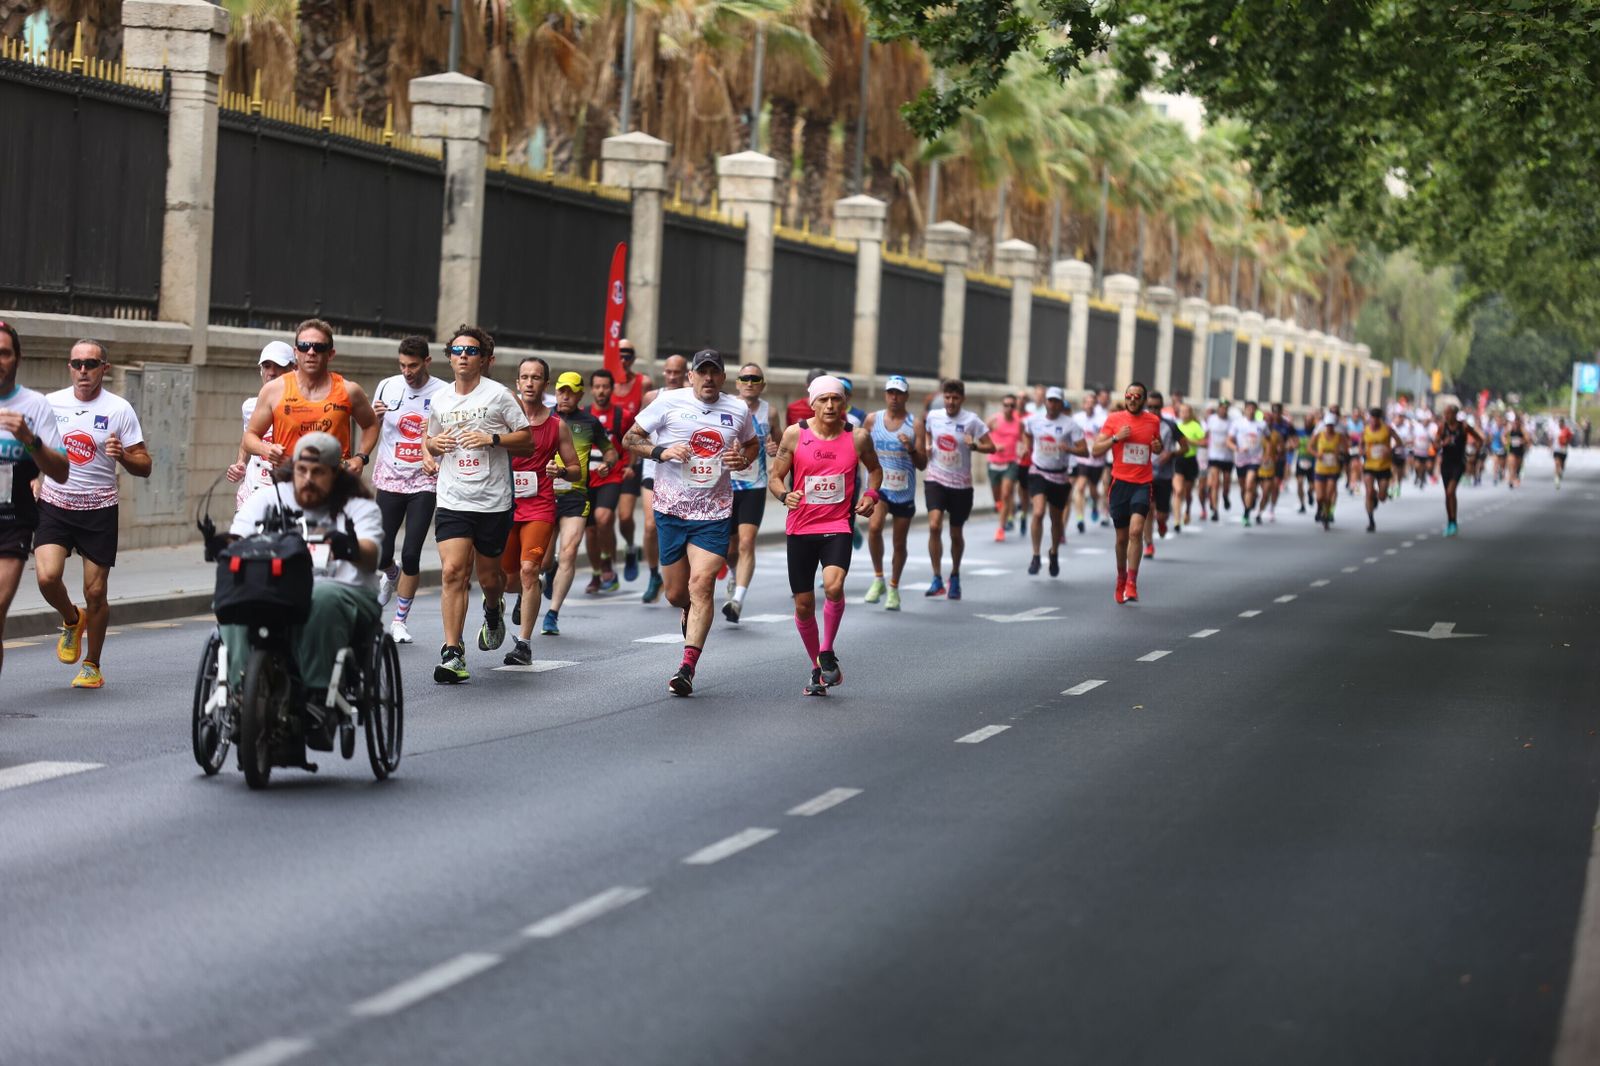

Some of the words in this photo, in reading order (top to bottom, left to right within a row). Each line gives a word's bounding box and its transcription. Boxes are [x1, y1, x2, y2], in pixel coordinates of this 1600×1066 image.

[66, 437, 92, 452] PONLE
[695, 434, 721, 447] PONLE
[458, 458, 480, 468] 826
[690, 466, 713, 475] 432
[814, 482, 836, 491] 676
